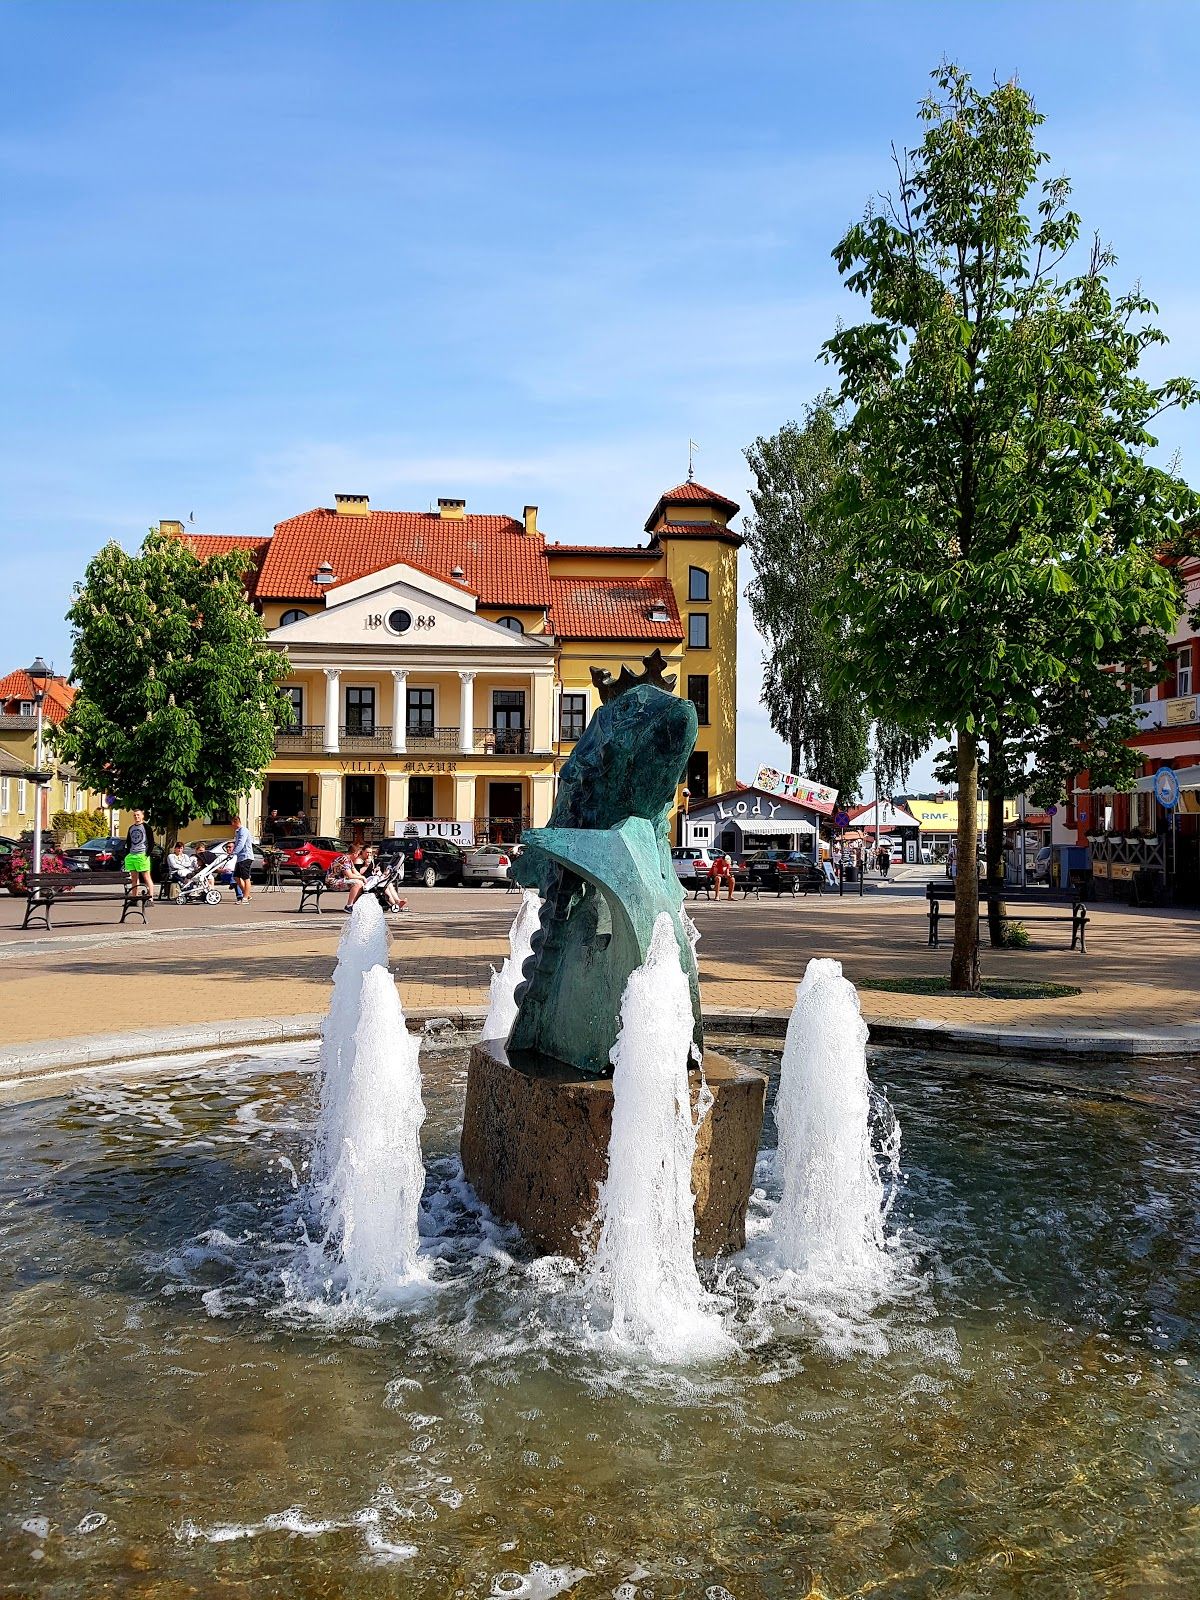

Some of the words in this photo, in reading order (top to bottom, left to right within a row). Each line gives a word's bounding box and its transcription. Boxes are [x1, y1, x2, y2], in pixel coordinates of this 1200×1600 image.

[368, 614, 382, 626] 18
[417, 615, 436, 627] 88
[340, 761, 387, 772] VILLA
[403, 761, 457, 773] MAZUR
[781, 774, 799, 787] LODY
[921, 812, 949, 820] RMF
[425, 822, 462, 837] PUB
